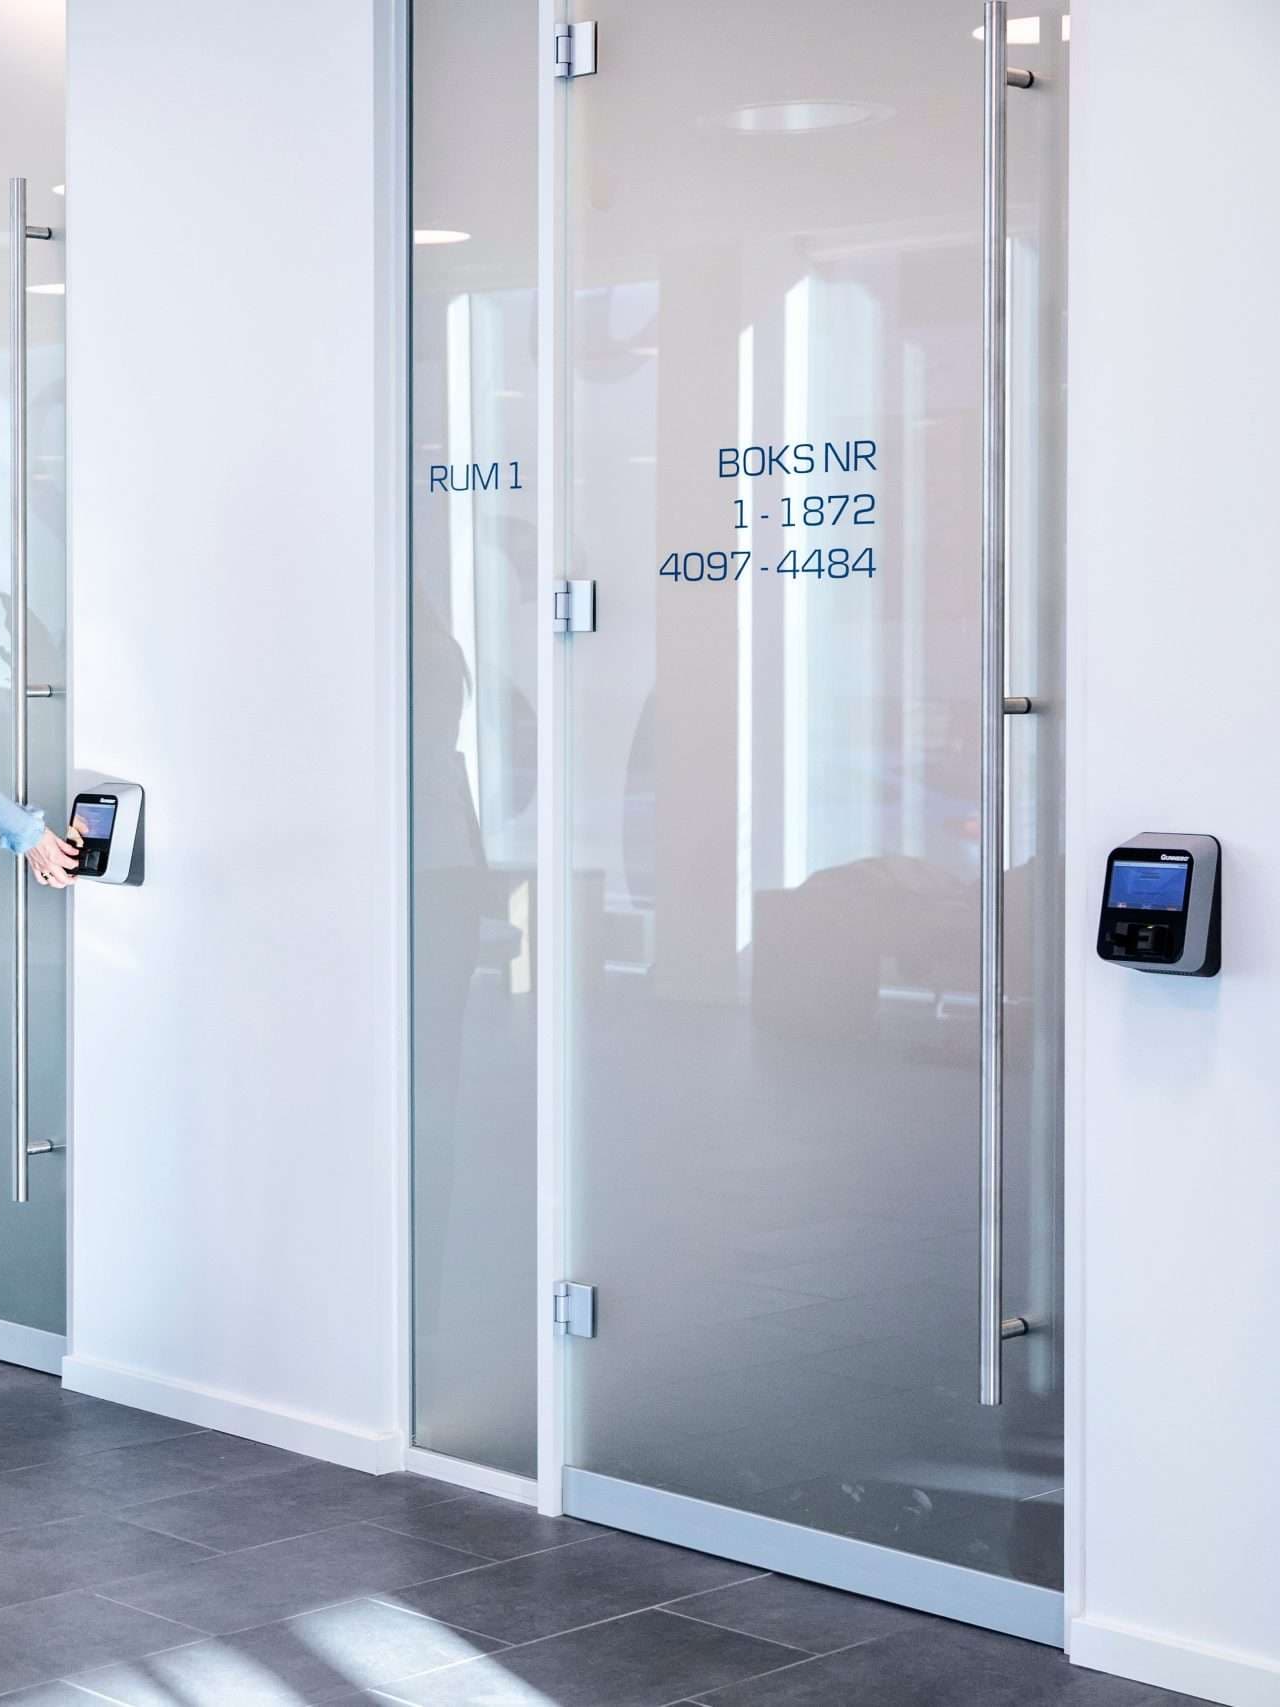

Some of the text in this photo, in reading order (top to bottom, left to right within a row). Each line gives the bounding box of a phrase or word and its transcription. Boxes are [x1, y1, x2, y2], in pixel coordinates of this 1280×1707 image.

[719, 440, 877, 478] BOKS NR
[429, 461, 522, 493] RUM 1
[781, 493, 876, 528] 1872
